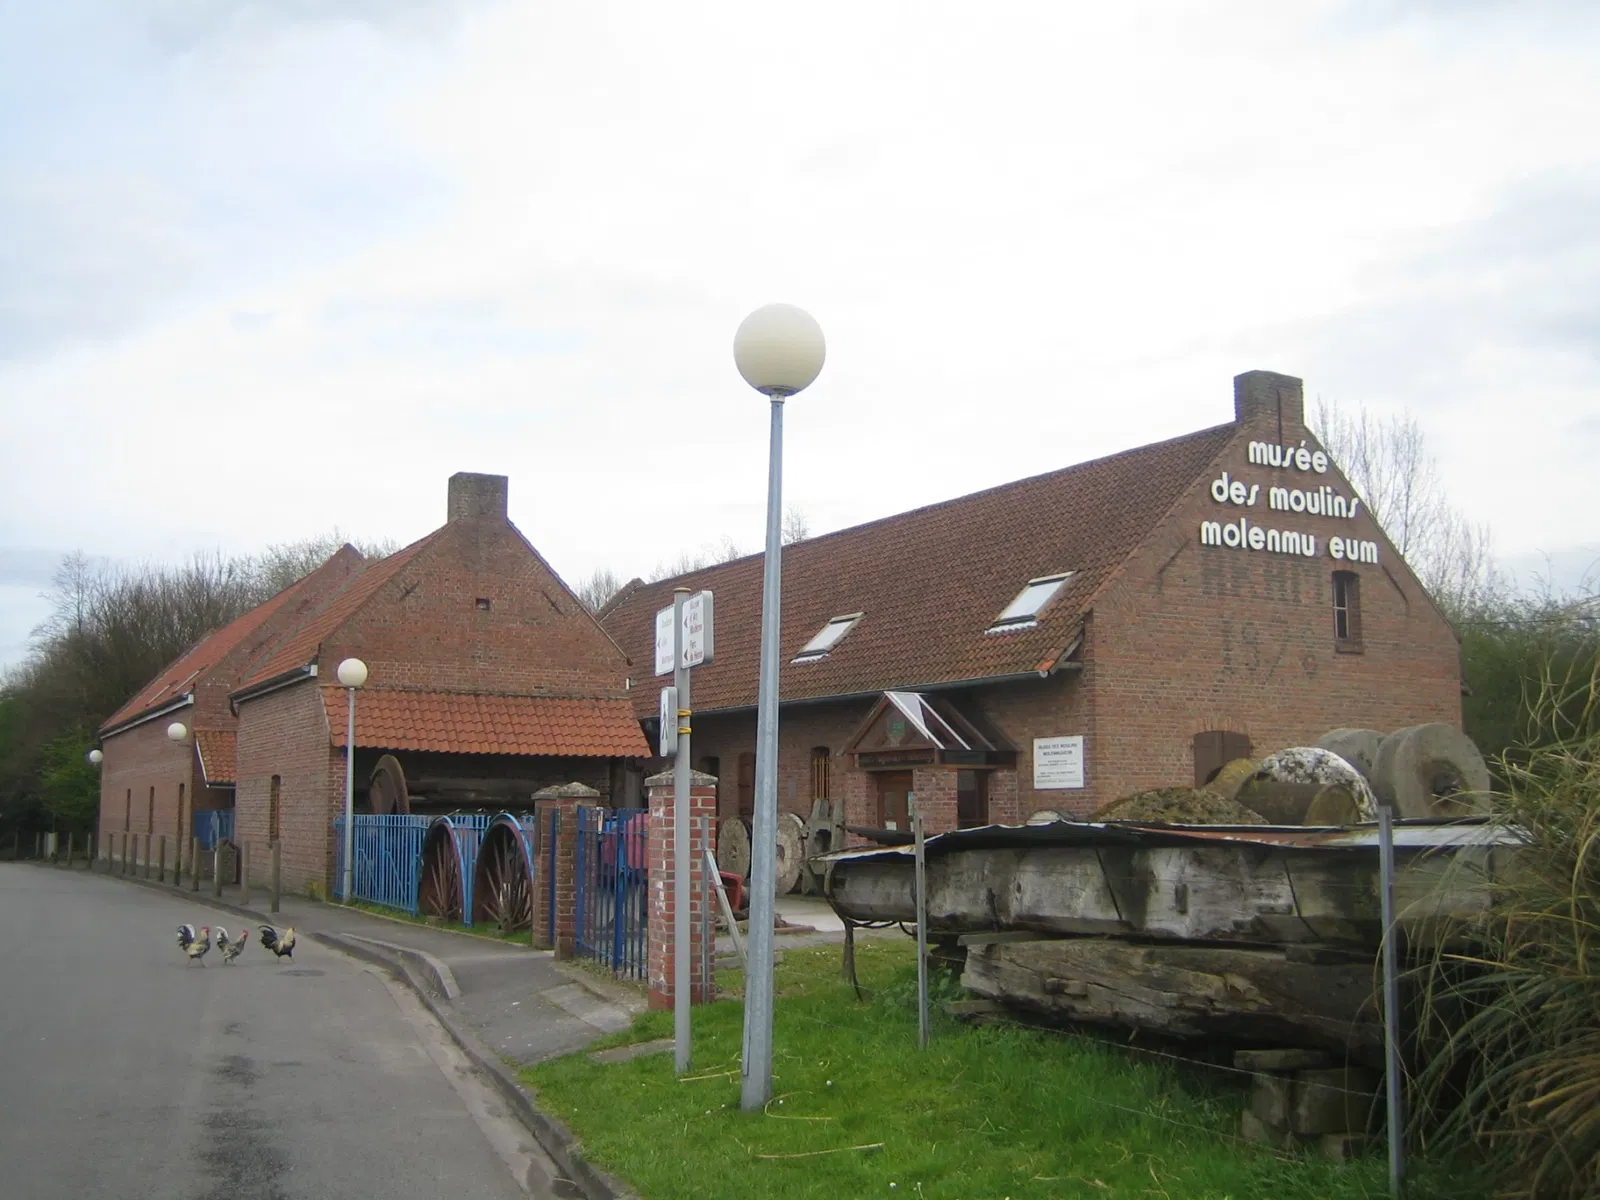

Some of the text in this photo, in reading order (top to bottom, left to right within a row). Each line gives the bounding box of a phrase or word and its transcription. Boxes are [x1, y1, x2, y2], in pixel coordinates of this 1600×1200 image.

[1248, 440, 1328, 473] musée
[1211, 472, 1359, 519] des moulins
[1201, 518, 1378, 564] molenmu eum
